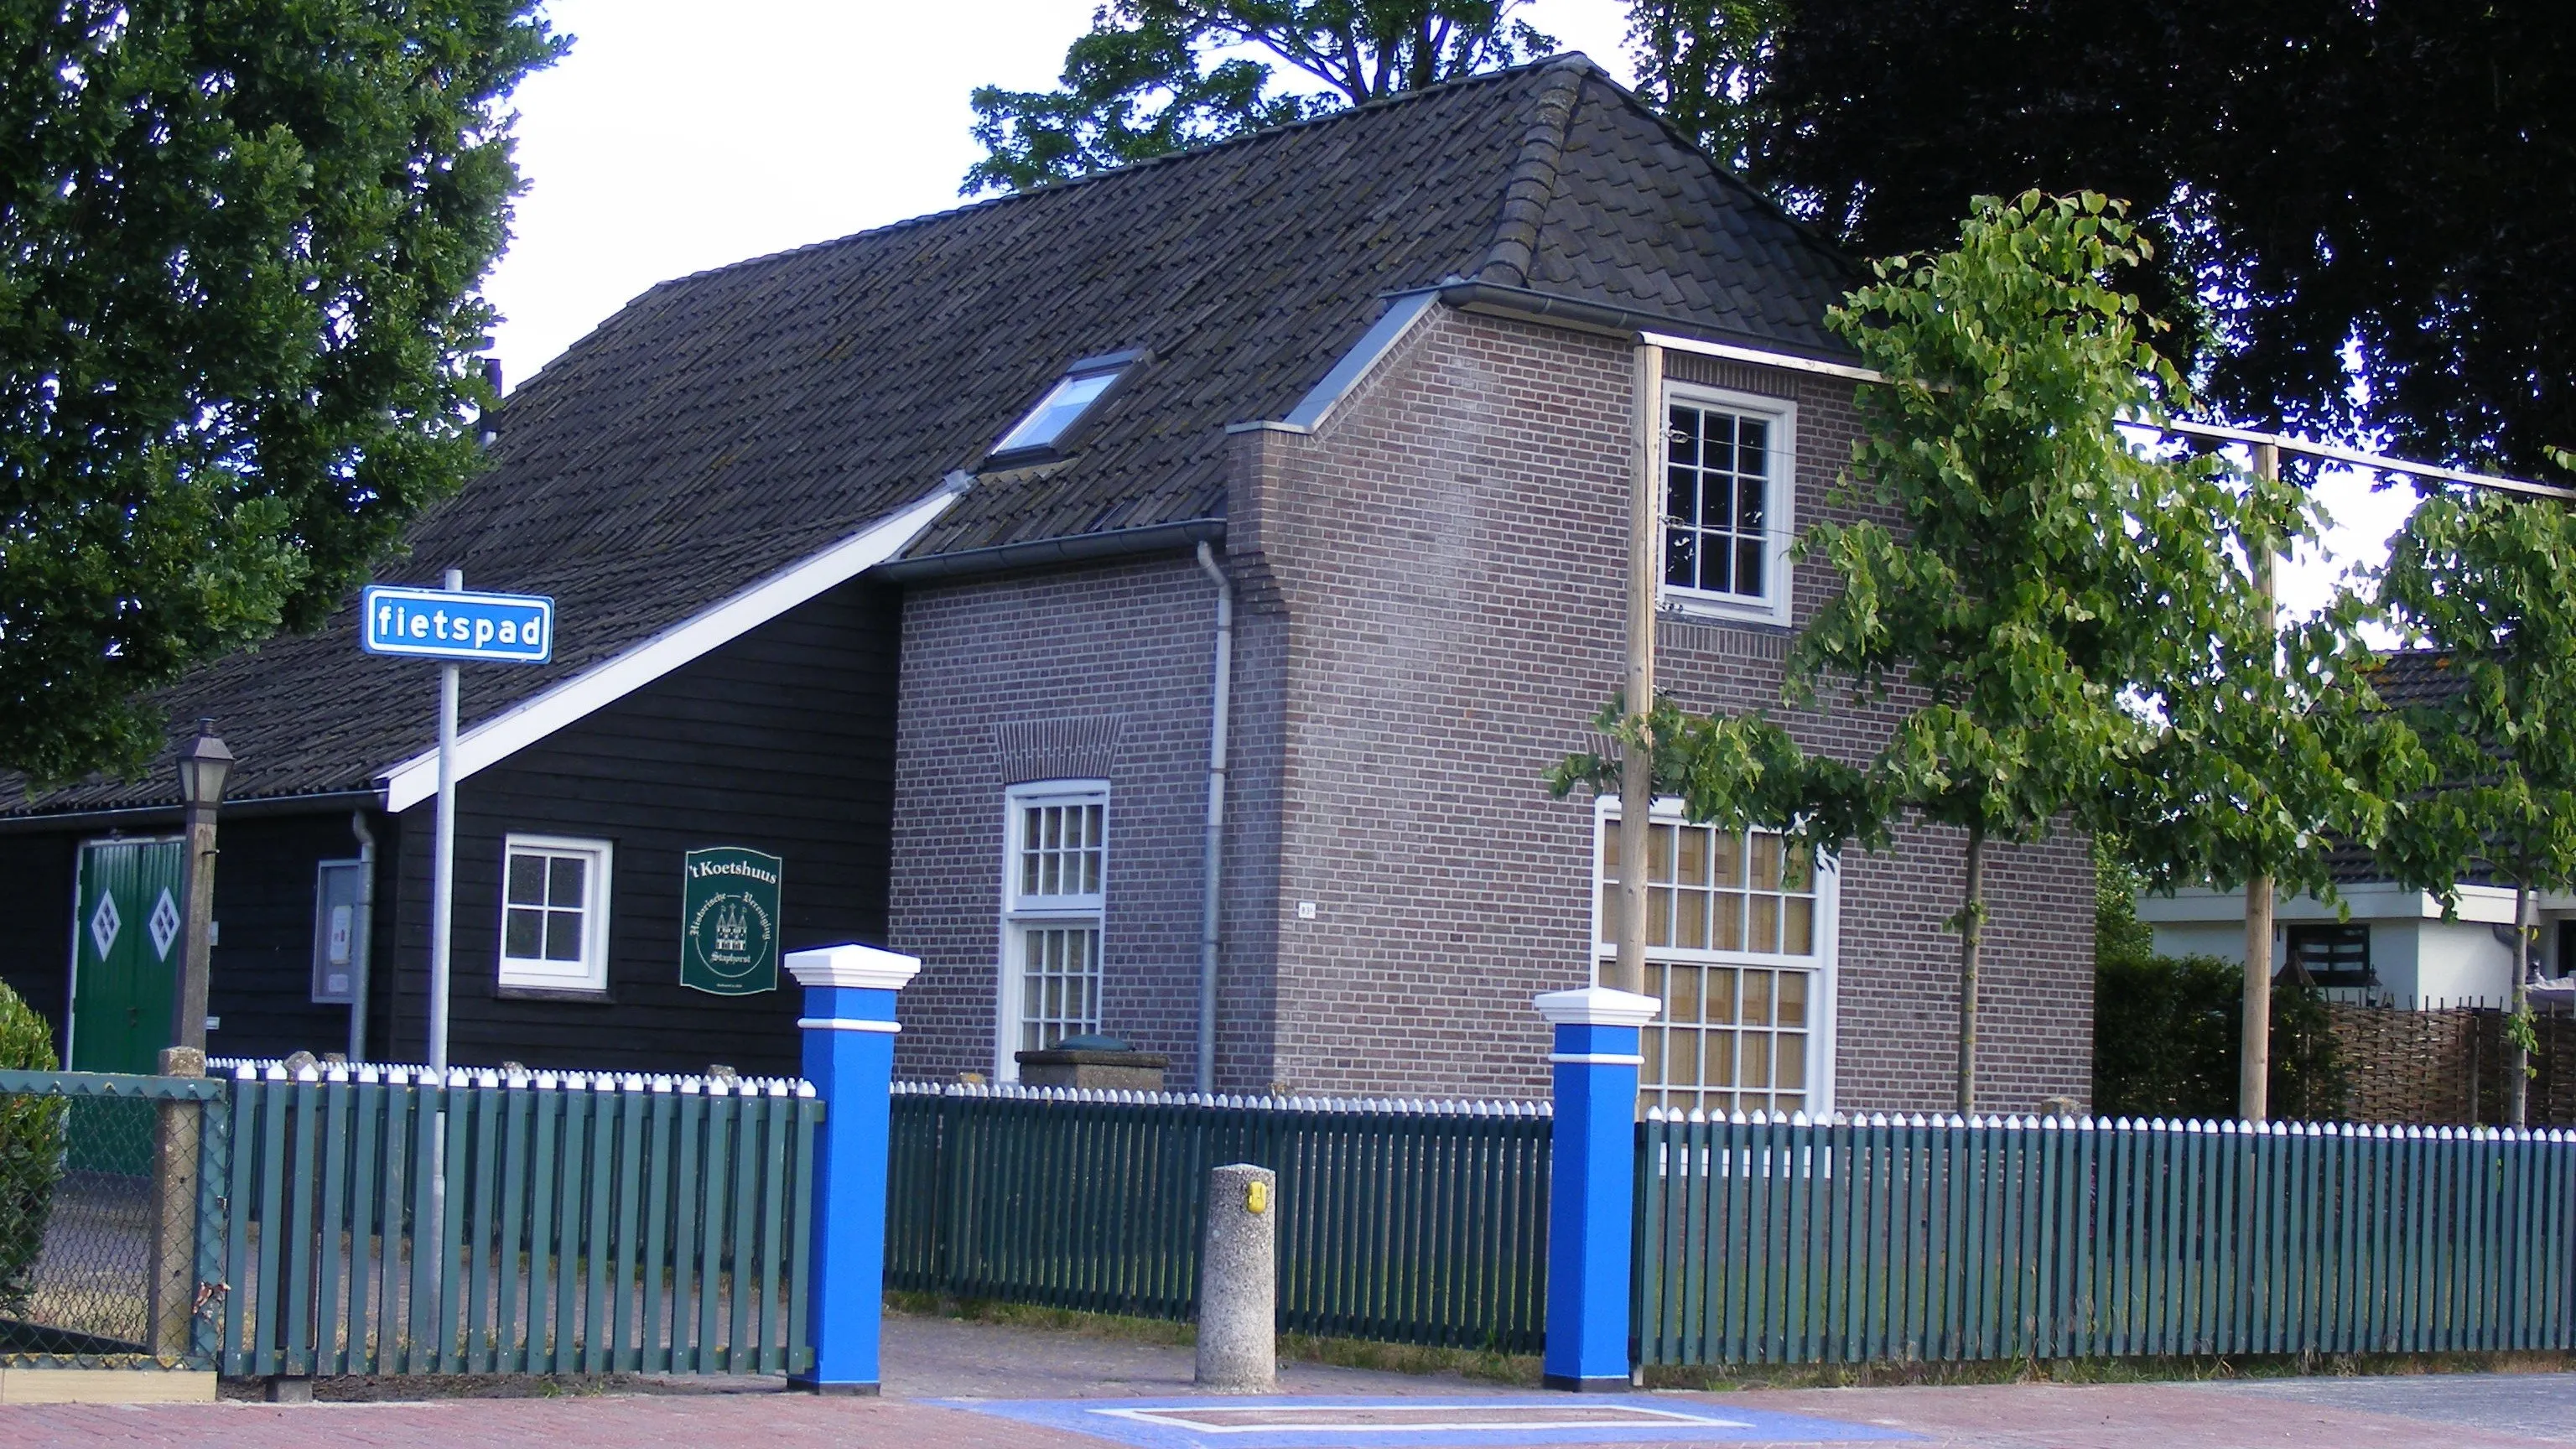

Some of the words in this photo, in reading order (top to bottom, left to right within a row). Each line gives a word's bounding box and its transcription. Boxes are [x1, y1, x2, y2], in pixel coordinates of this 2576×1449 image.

[379, 605, 541, 649] fietspad
[689, 865, 699, 878] 't
[700, 860, 777, 884] Koetshuus
[710, 951, 750, 965] Staphorst
